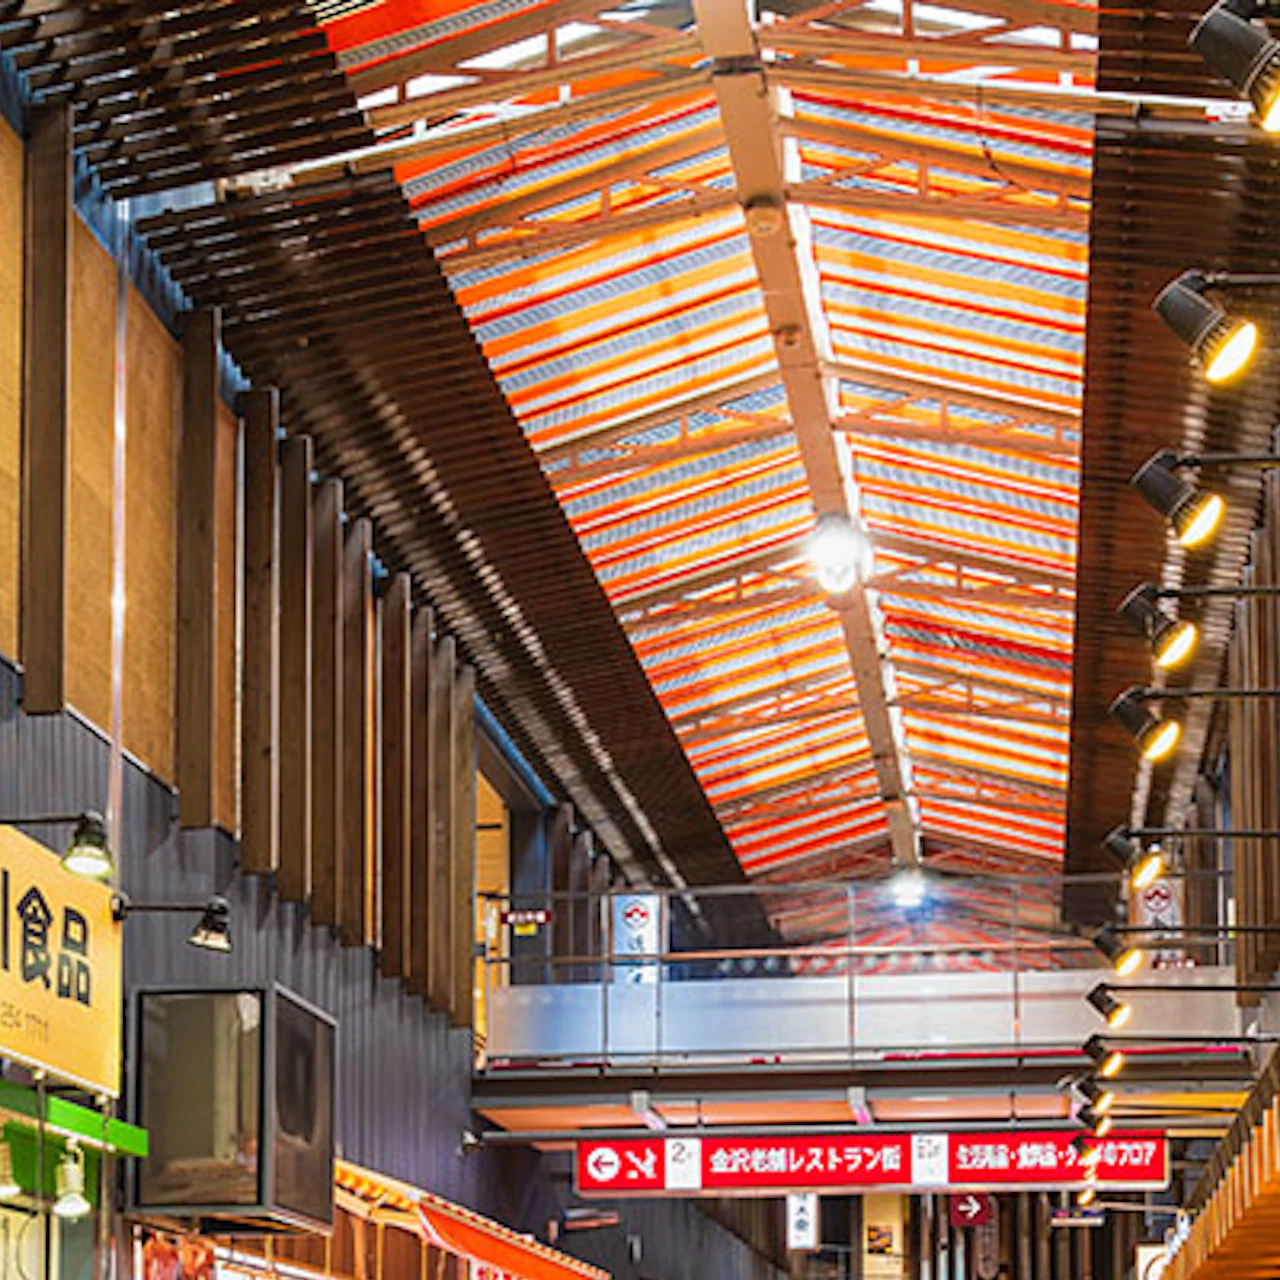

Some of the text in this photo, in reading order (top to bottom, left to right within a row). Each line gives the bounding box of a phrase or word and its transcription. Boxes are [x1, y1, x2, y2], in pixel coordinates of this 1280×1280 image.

[708, 1143, 902, 1174] 金沢老舗レストラン街
